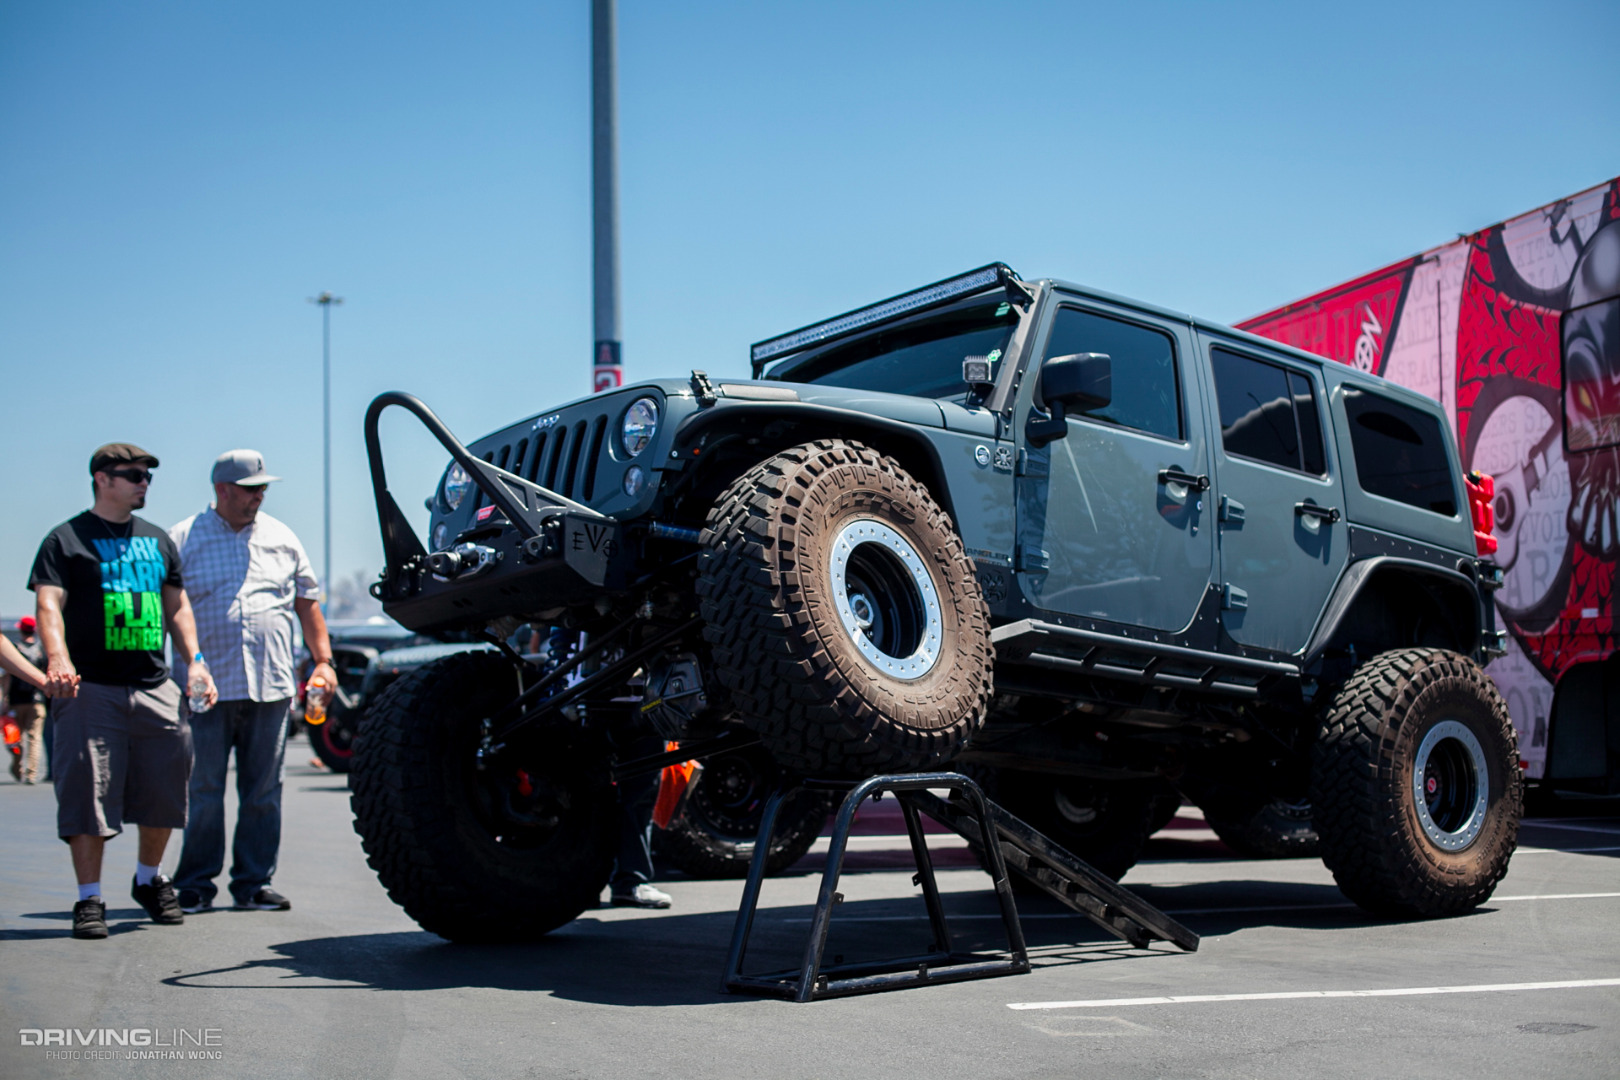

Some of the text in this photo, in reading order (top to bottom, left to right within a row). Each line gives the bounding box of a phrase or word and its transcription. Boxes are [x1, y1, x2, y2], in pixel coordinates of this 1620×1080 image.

[92, 536, 164, 563] WORK
[100, 560, 166, 593] HARD
[104, 592, 162, 628] PLAY
